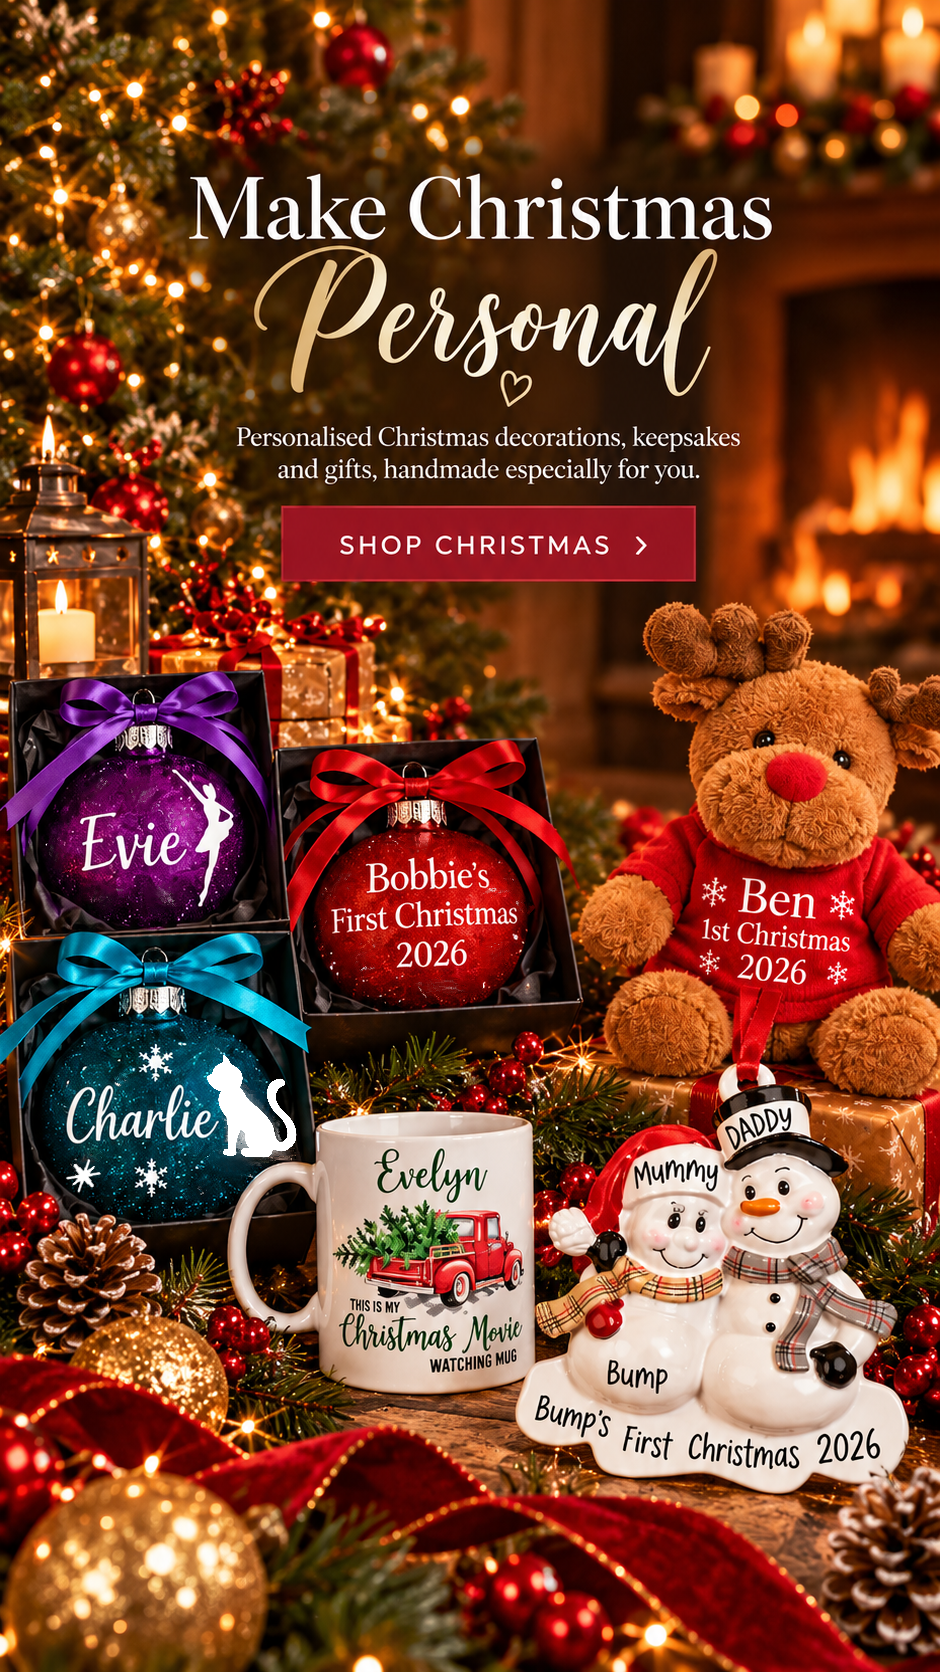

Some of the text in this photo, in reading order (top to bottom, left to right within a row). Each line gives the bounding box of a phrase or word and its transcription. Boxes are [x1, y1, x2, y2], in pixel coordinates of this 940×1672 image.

[80, 813, 187, 872] Evie
[366, 857, 490, 894] Bobbie's
[738, 877, 816, 919] Ben
[331, 901, 518, 934] First Christmas
[701, 918, 850, 952] 1st Christmas
[396, 939, 467, 968] 2026
[737, 954, 807, 985] 2026
[66, 1085, 219, 1144] Charlie
[725, 1107, 792, 1150] DADDY
[374, 1148, 488, 1203] Evelyn
[634, 1159, 719, 1192] Mummy
[350, 1298, 400, 1313] THIS IS MY
[339, 1313, 523, 1354] Christmas Movie
[430, 1348, 517, 1373] WATCHING MUG
[607, 1359, 668, 1393] Bump
[535, 1395, 881, 1470] Bump's First Christmas 2026
